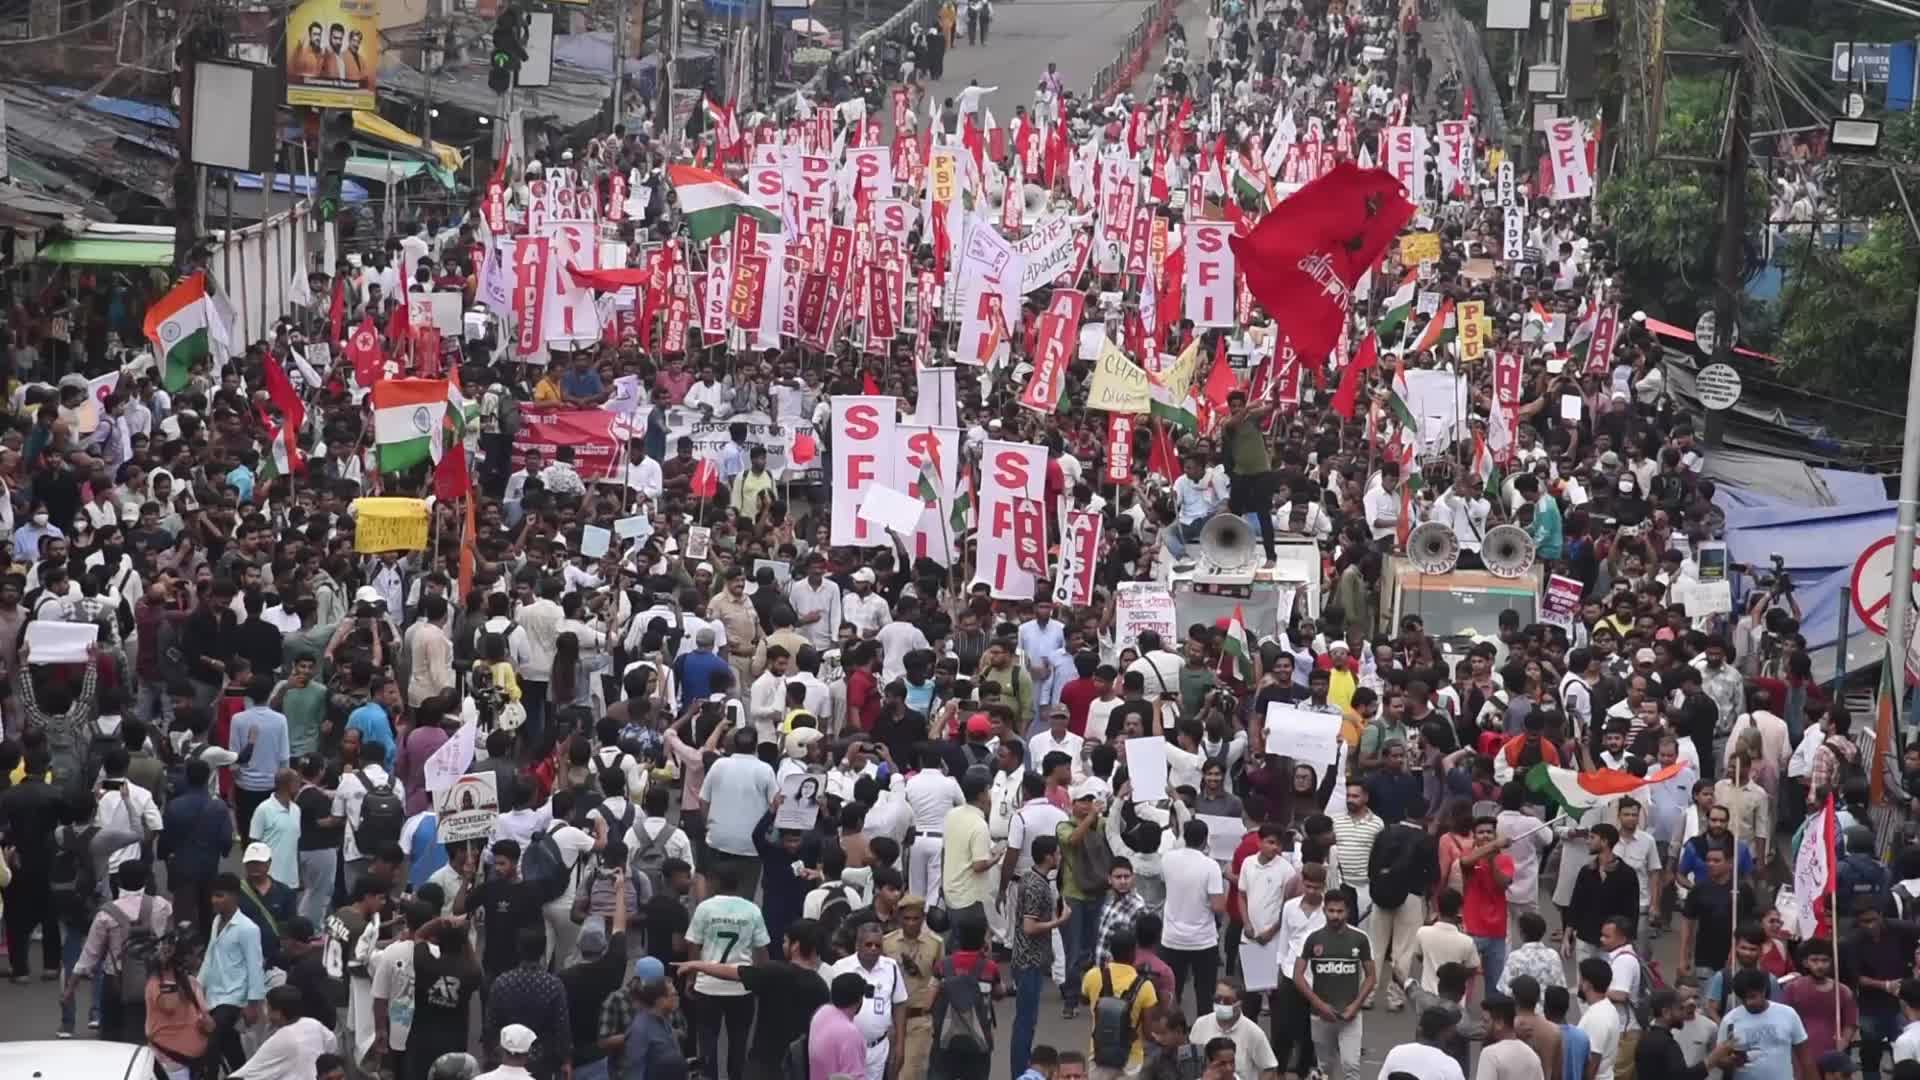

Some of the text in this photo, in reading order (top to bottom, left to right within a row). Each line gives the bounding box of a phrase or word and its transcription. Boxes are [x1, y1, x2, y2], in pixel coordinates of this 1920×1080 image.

[936, 157, 950, 199] PSU
[1502, 164, 1512, 206] AIDYO
[1552, 122, 1576, 193] SFI
[1130, 208, 1149, 268] AISA
[1152, 221, 1164, 264] PSU
[1508, 208, 1519, 257] AIDYO
[521, 243, 541, 348] AIDSO
[710, 267, 725, 329] AISB
[731, 269, 752, 317] PSU
[782, 275, 796, 333] AISB
[1196, 228, 1222, 320] SFI
[1033, 296, 1072, 402] AIDSO
[1464, 305, 1479, 357] PSU
[1590, 308, 1613, 368] AISA
[844, 404, 879, 538] SFI
[1111, 418, 1131, 479] AIDSO
[993, 452, 1029, 591] SFI
[1017, 502, 1042, 569] AISA
[1070, 515, 1092, 600] AISA
[717, 931, 738, 964] 7
[1316, 961, 1356, 974] adidas
